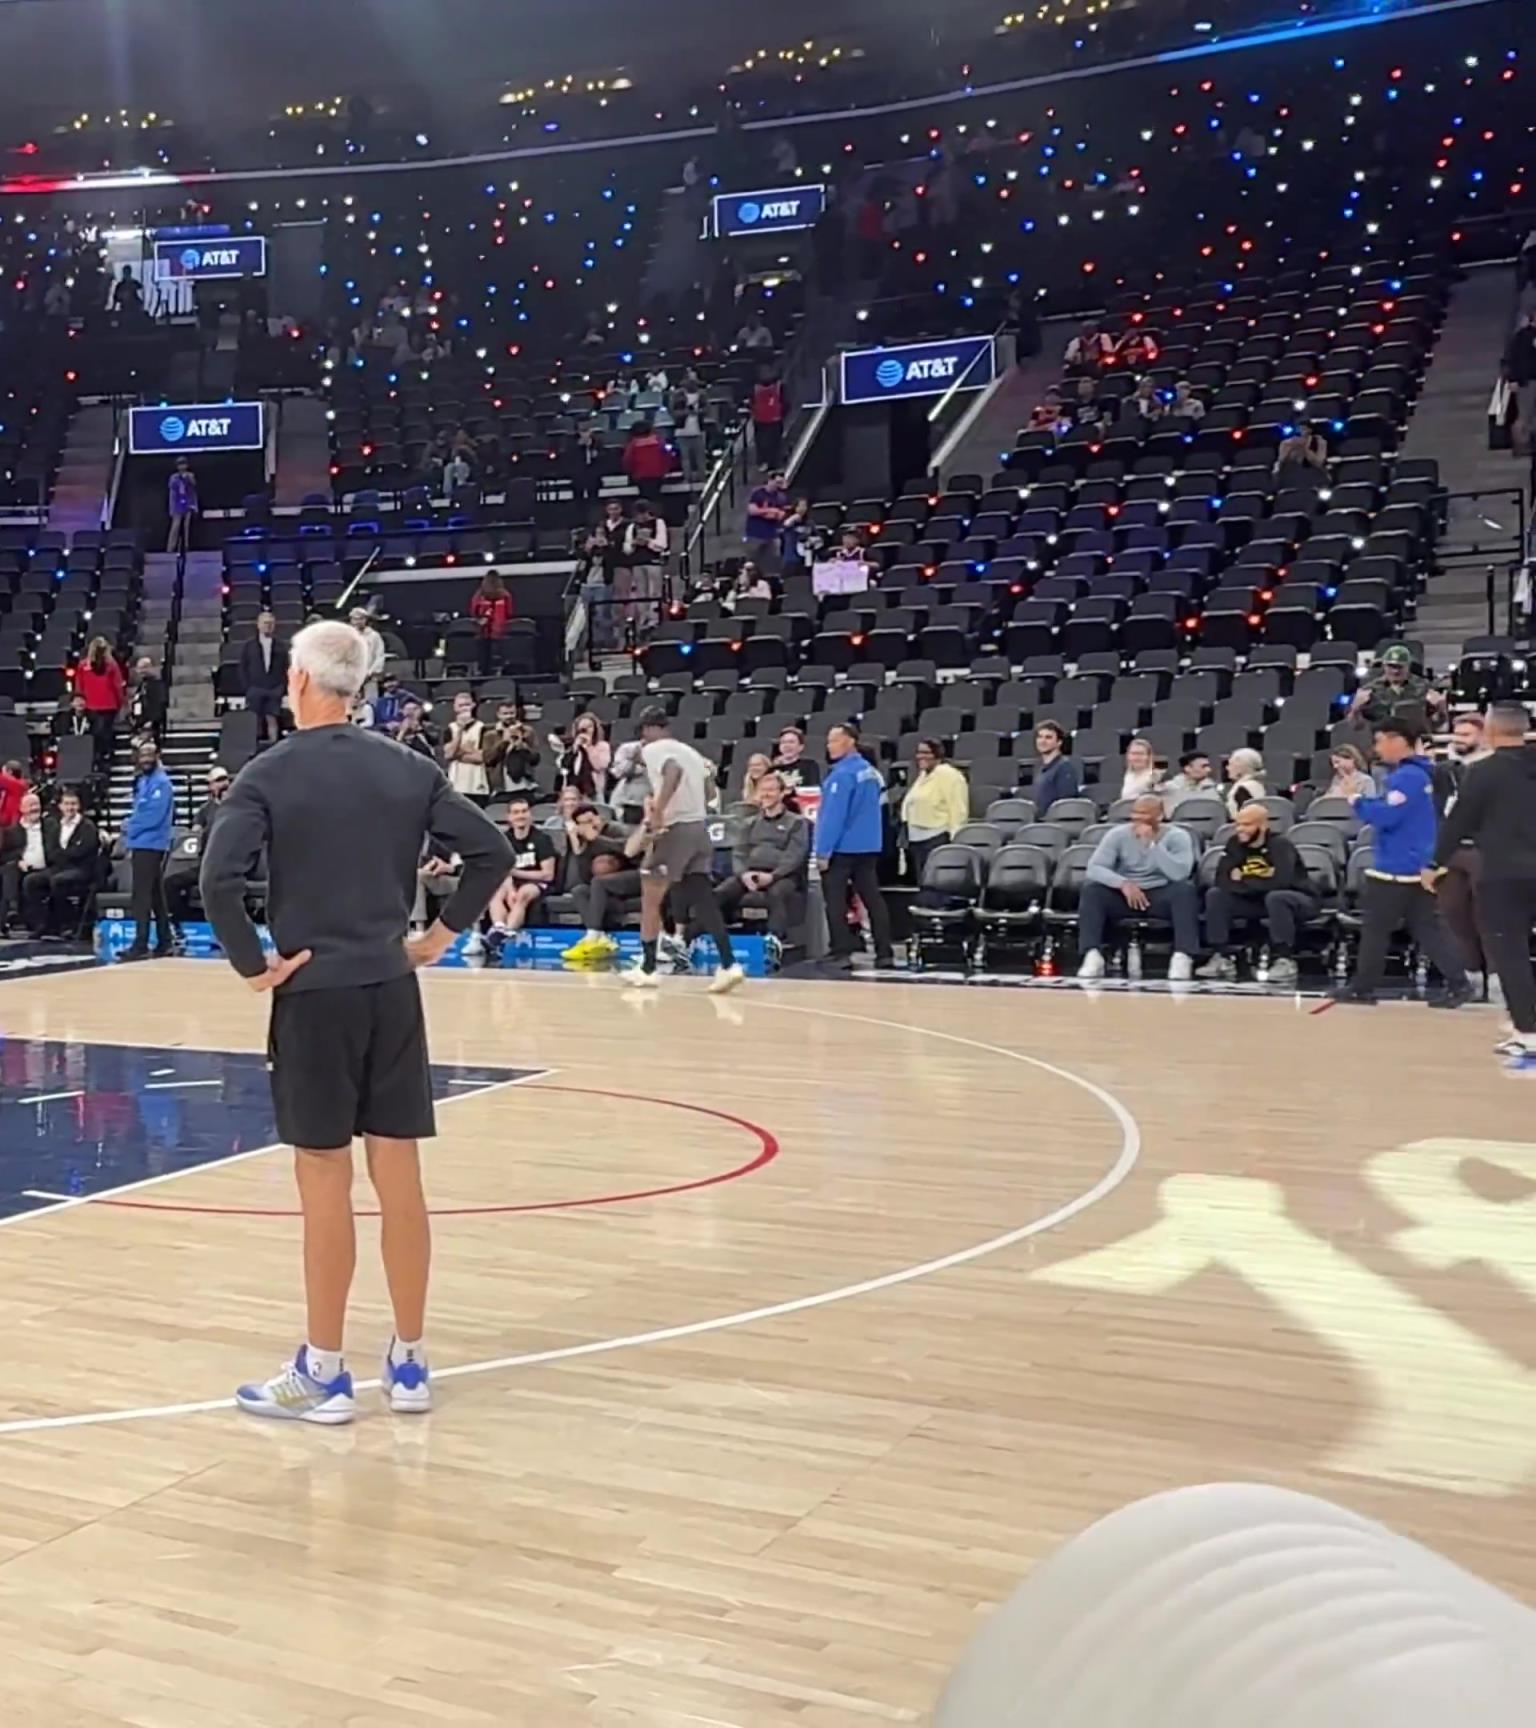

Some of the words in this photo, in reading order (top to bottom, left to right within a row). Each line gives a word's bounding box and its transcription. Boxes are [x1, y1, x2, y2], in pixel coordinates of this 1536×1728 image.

[761, 200, 801, 219] AT&T
[202, 249, 240, 266] AT&T
[905, 356, 958, 381] AT&T
[186, 418, 231, 437] AT&T
[184, 837, 198, 853] G
